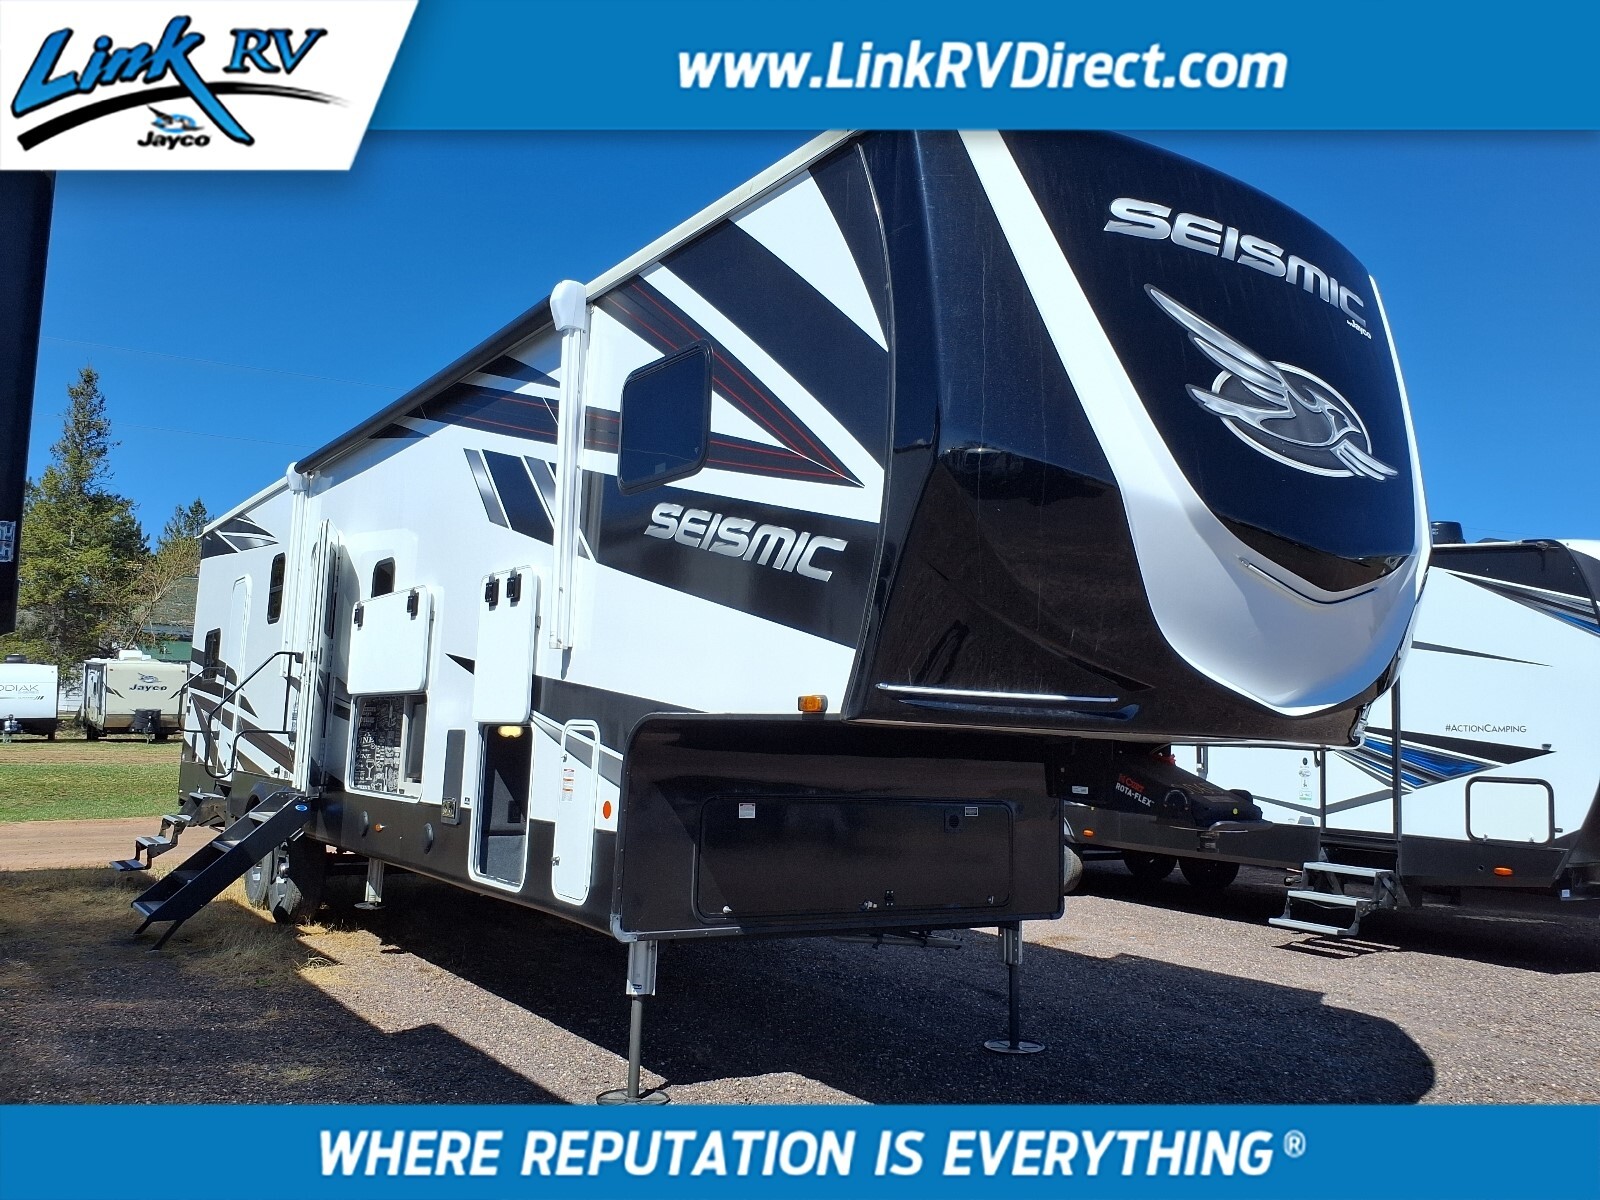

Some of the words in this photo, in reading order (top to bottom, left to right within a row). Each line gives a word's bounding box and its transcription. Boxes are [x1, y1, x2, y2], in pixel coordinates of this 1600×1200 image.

[1103, 197, 1367, 327] SEISMIC
[644, 502, 849, 582] SEISMIC
[129, 684, 168, 692] Jayco
